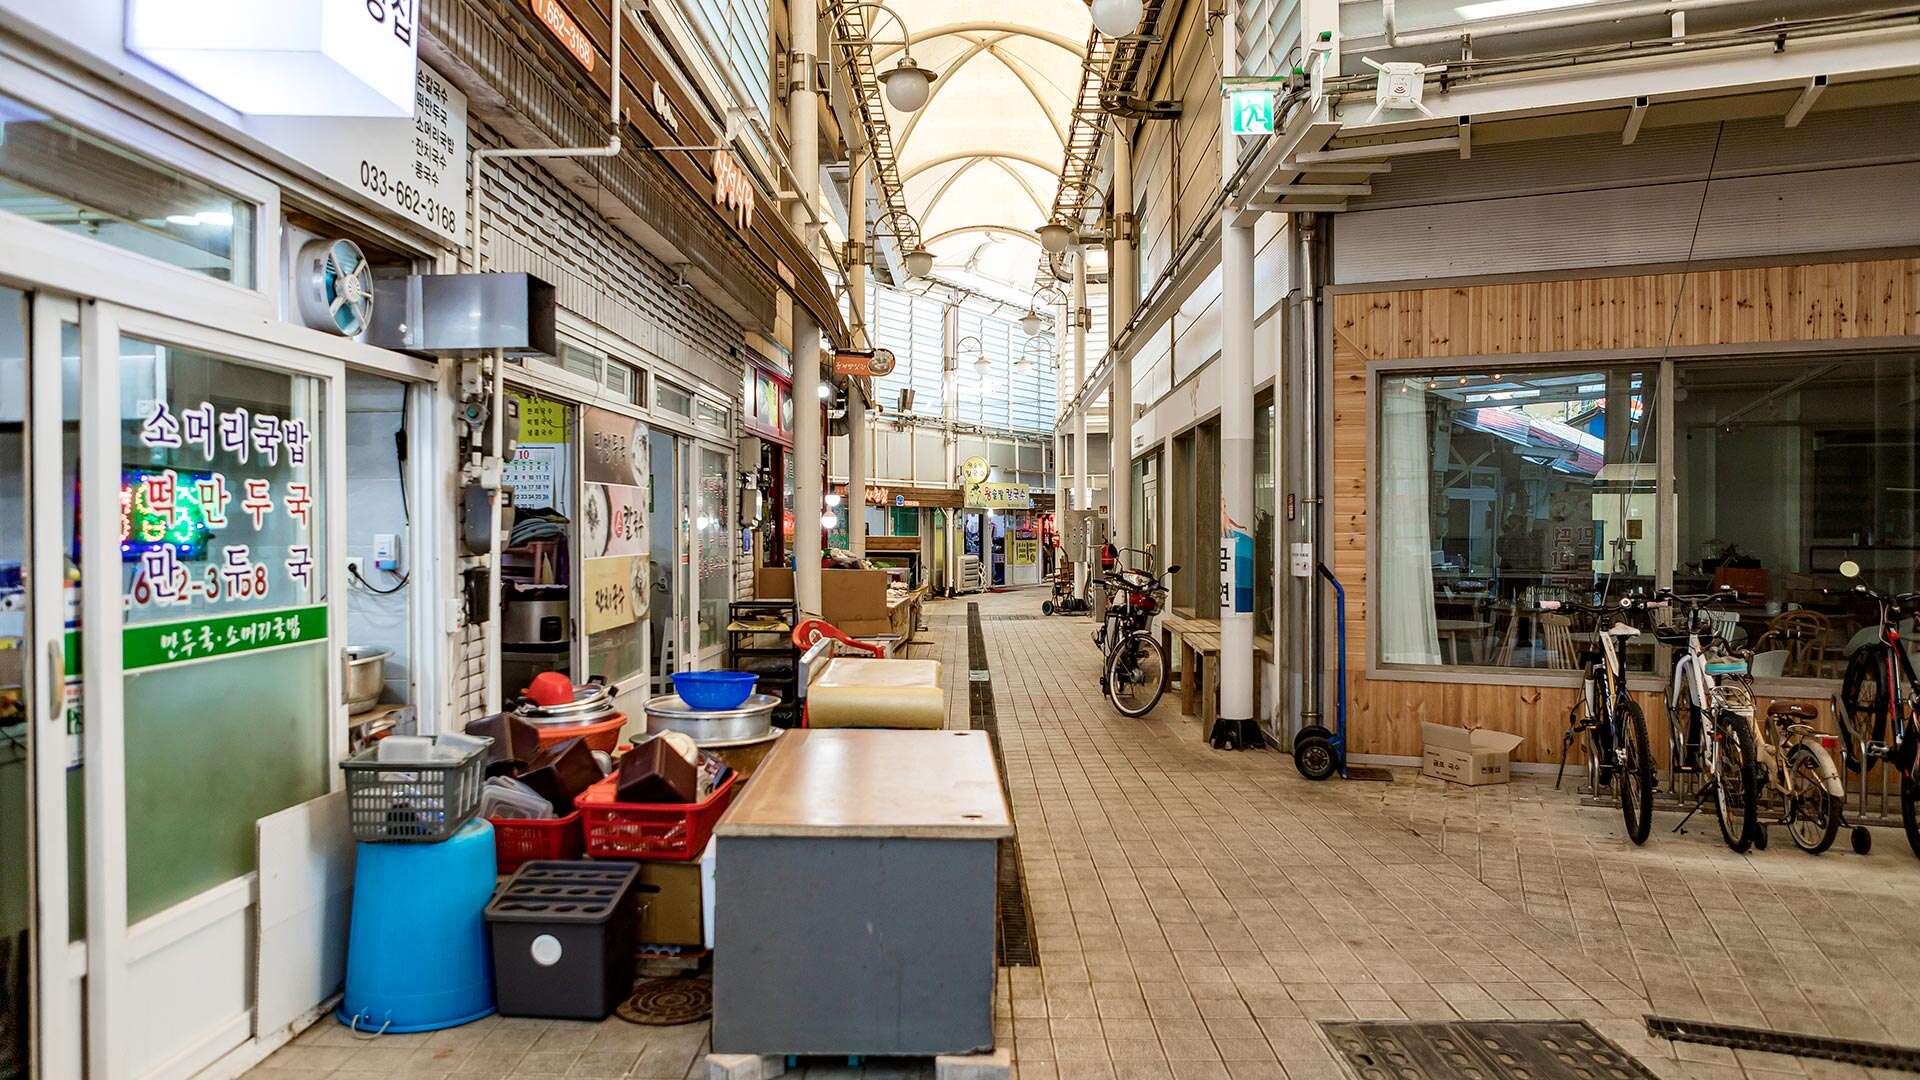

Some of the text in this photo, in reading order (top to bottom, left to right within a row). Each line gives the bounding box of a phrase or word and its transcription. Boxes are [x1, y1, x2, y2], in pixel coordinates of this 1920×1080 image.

[417, 69, 449, 105] 손칼국수
[416, 92, 448, 128] 떡만두국
[416, 116, 455, 155] 소머리국밥
[360, 160, 456, 234] 033-662-3168
[143, 402, 310, 465] 소머리국밥
[519, 450, 529, 460] 10
[1005, 487, 1026, 502] 칼국수
